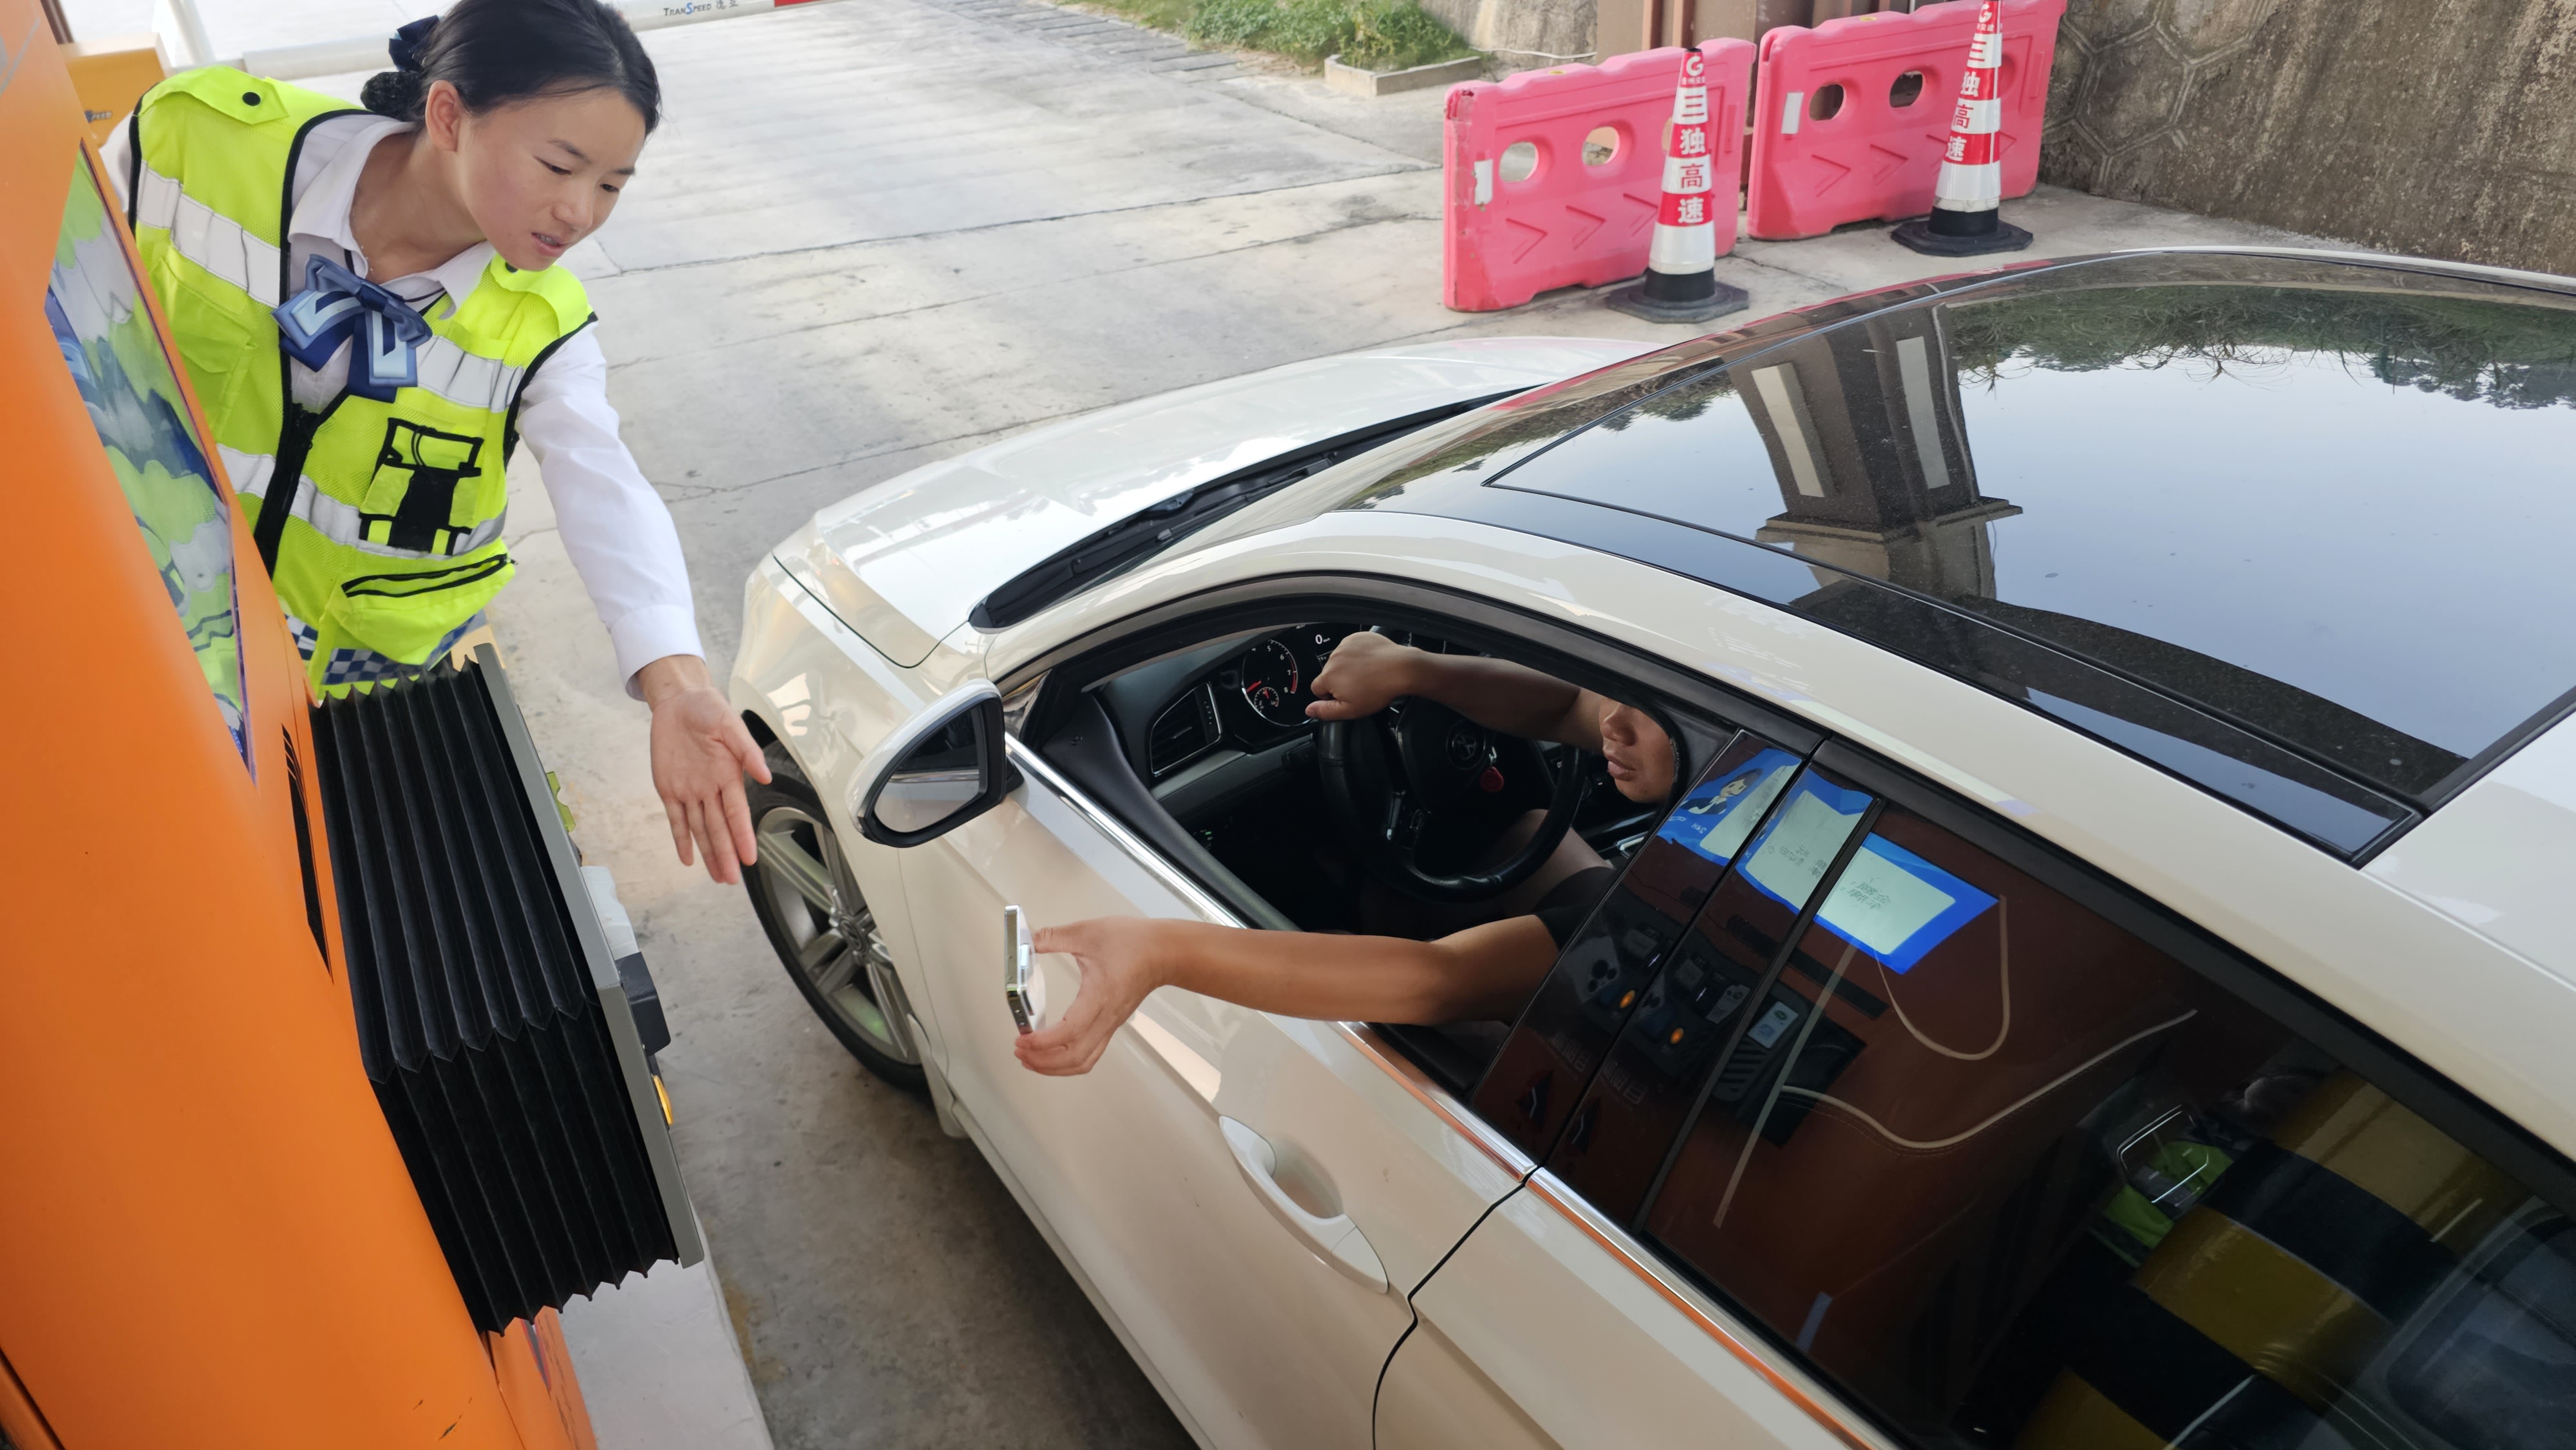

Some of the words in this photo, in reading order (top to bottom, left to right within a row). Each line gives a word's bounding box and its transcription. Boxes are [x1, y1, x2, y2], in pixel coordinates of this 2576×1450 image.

[1685, 55, 1704, 77] G
[1945, 41, 1987, 162] 三独高速
[1678, 94, 1706, 224] 三独高速
